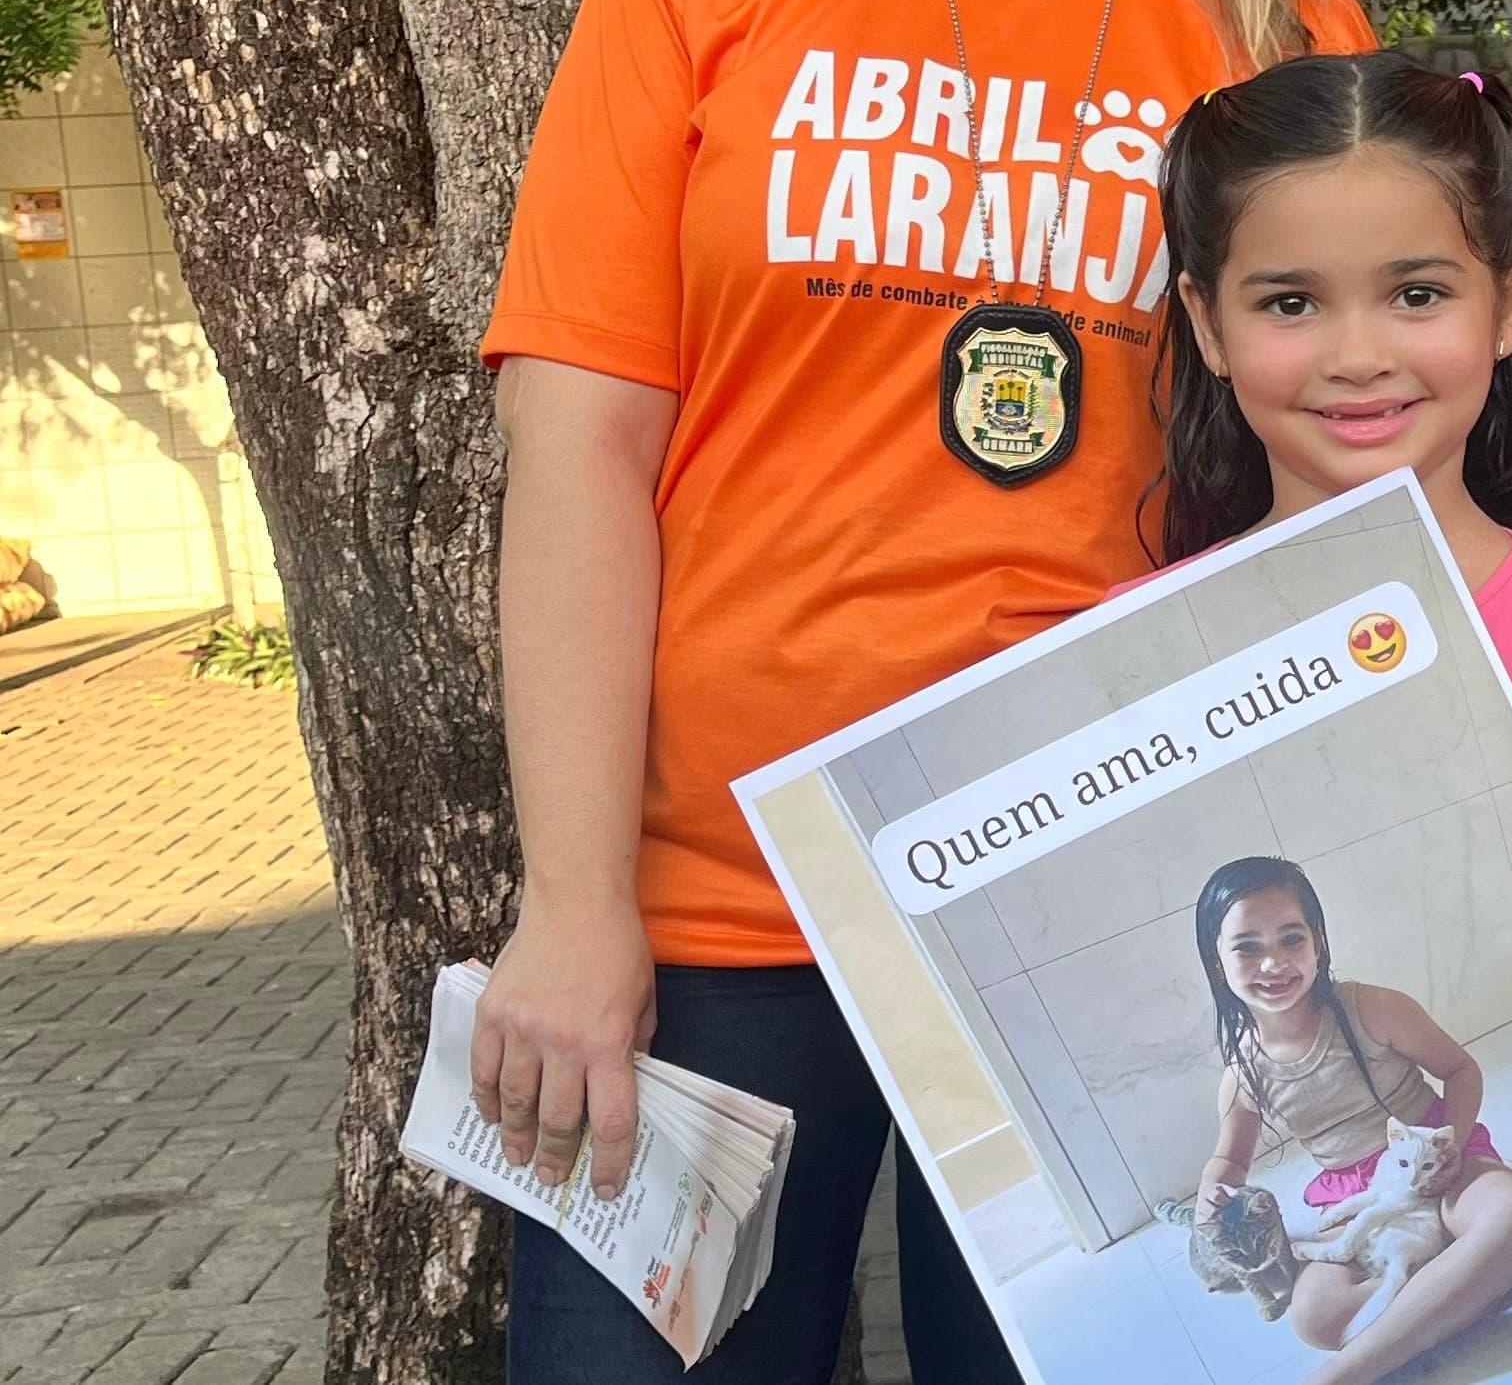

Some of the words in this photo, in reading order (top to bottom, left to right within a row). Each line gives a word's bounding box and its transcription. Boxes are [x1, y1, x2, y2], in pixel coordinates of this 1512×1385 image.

[770, 49, 1062, 163] ABRIL
[806, 278, 846, 297] Mês
[851, 280, 874, 298] de
[881, 285, 968, 311] combate
[1092, 319, 1151, 347] animal
[905, 788, 1065, 891] Quem
[1070, 729, 1200, 807] ama,
[1202, 652, 1343, 741] cuida
[448, 1141, 455, 1149] O
[452, 1105, 471, 1136] Estado
[457, 1114, 480, 1156] Conselho
